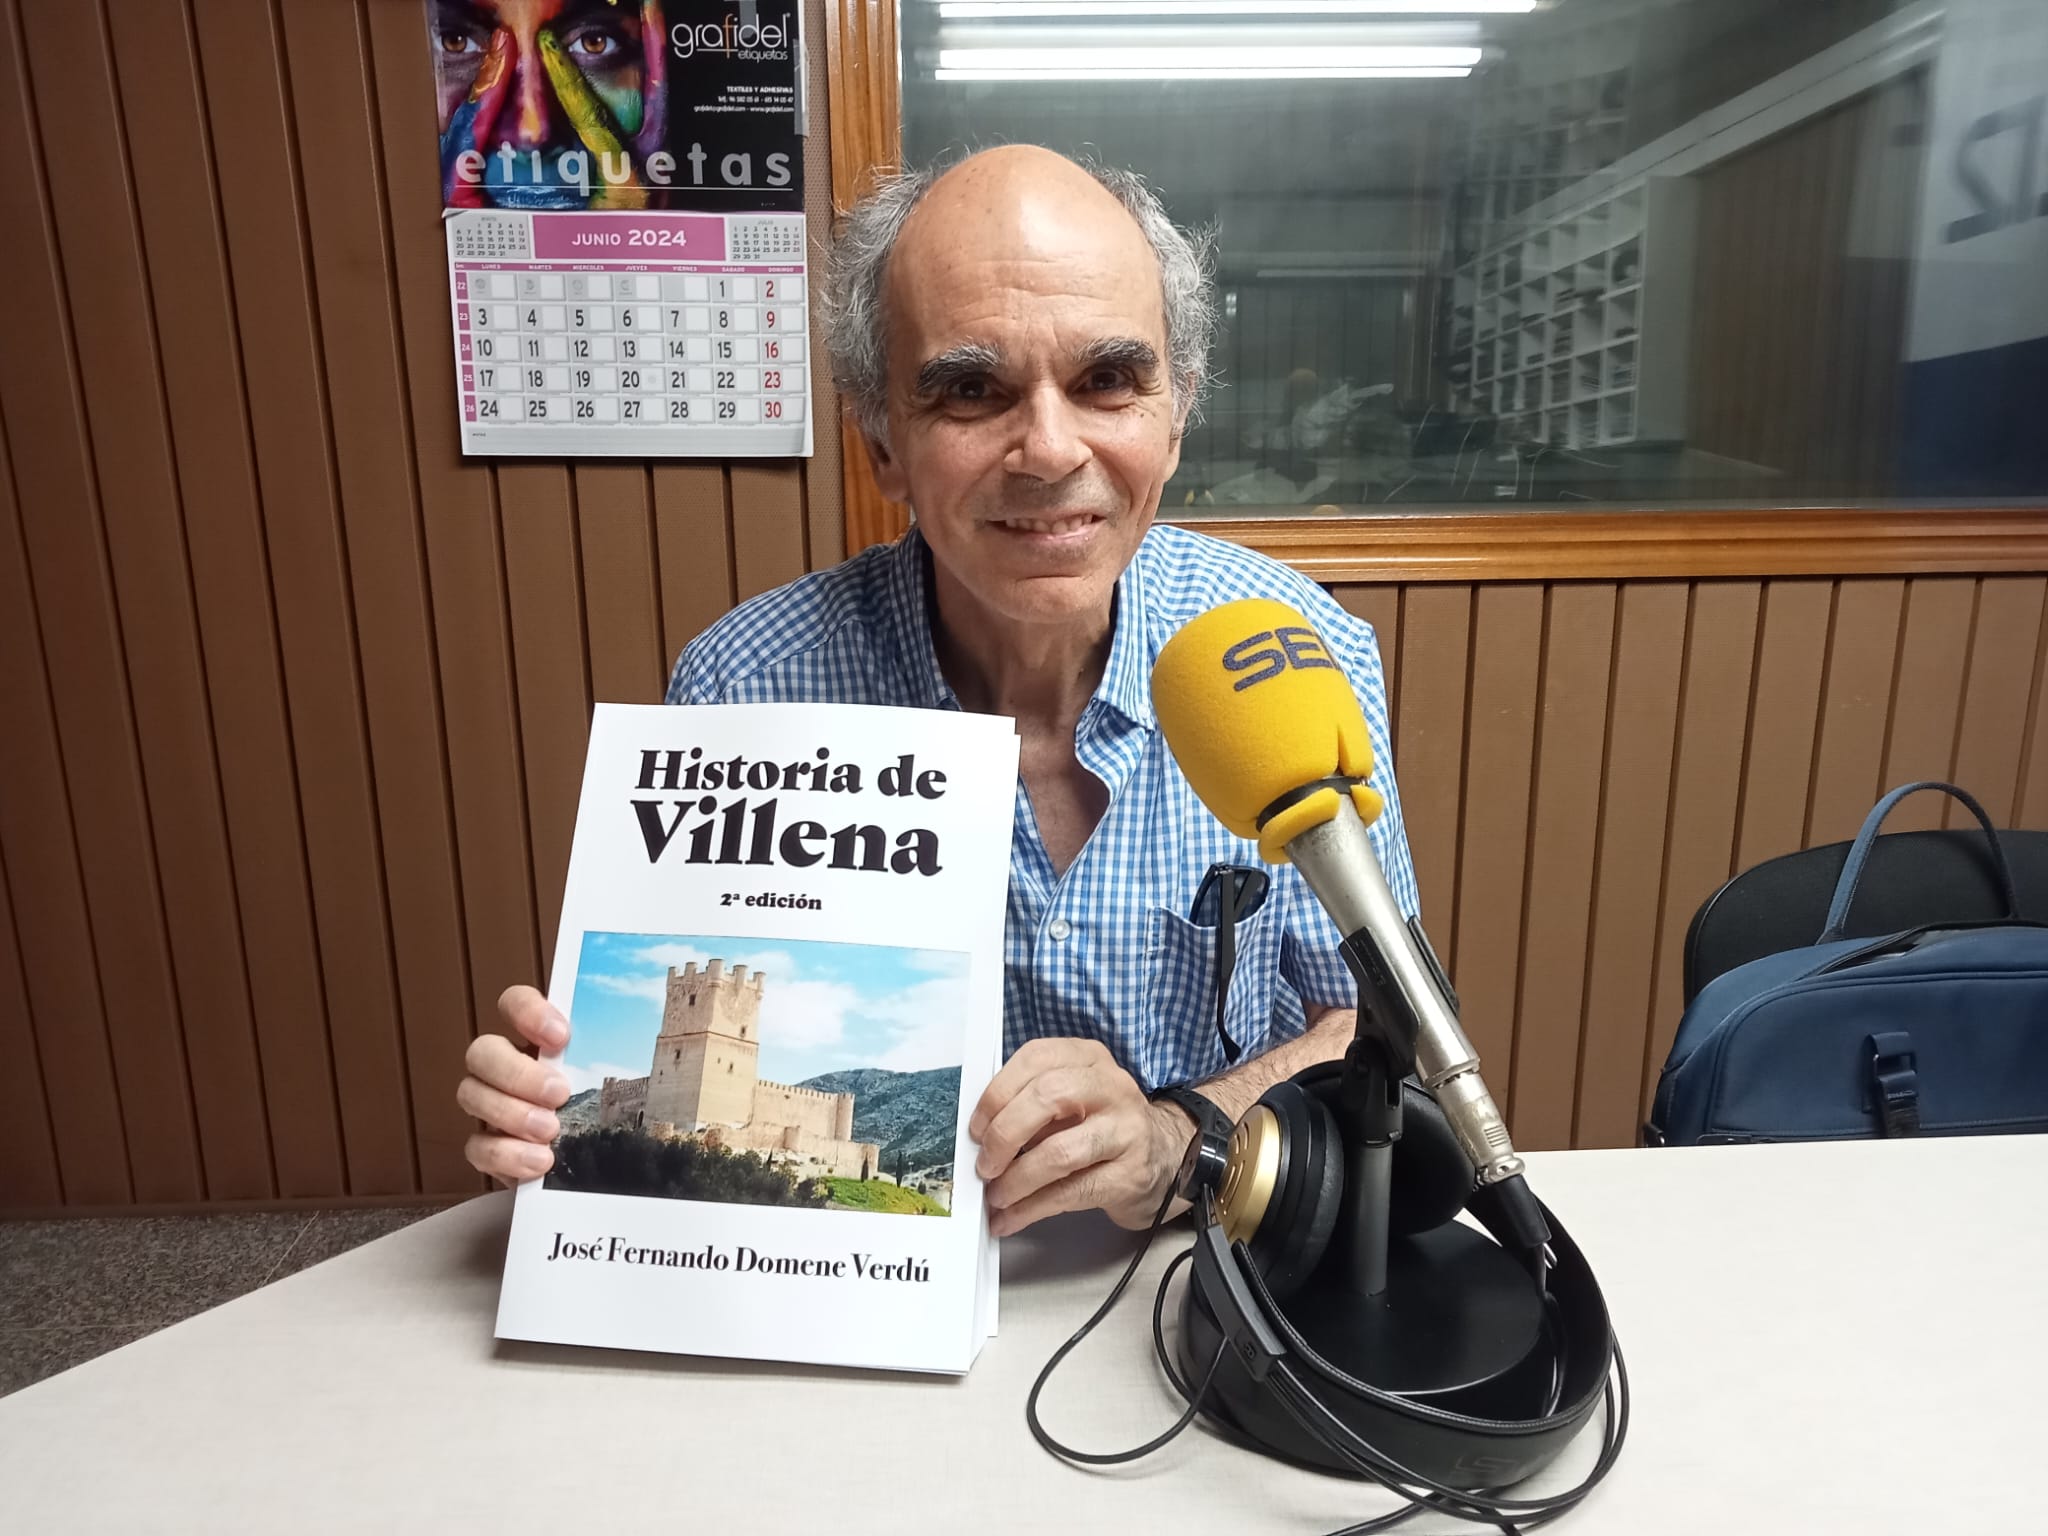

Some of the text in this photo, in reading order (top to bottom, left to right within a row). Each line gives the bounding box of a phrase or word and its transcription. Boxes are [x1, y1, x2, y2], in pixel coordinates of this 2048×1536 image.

[738, 49, 788, 63] etiquetas
[455, 141, 791, 197] etiquetas
[571, 230, 687, 247] JUNIO 2024
[457, 281, 775, 297] 22 1 2
[459, 309, 775, 328] 23 3 4 5 6 7 8 9
[477, 339, 493, 356] 10
[528, 341, 539, 357] 11
[574, 340, 589, 357] 12
[622, 341, 636, 358] 13
[669, 341, 685, 358] 14
[717, 341, 732, 358] 15
[764, 342, 779, 358] 16
[479, 370, 494, 386] 17
[527, 371, 544, 387] 18
[575, 371, 591, 387] 19
[621, 371, 640, 387] 20
[671, 372, 686, 388] 21
[717, 372, 735, 388] 22
[764, 372, 781, 388] 23
[479, 400, 499, 416] 24
[528, 401, 547, 417] 25
[576, 401, 594, 417] 26
[623, 401, 641, 417] 27
[671, 402, 689, 418] 28
[718, 402, 736, 418] 29
[765, 402, 782, 418] 30
[1223, 627, 1343, 692] SE
[635, 747, 946, 799] Historia de
[631, 795, 942, 876] Villena
[746, 893, 821, 909] edición
[548, 1234, 928, 1283] José Fernando Domene Verdú
